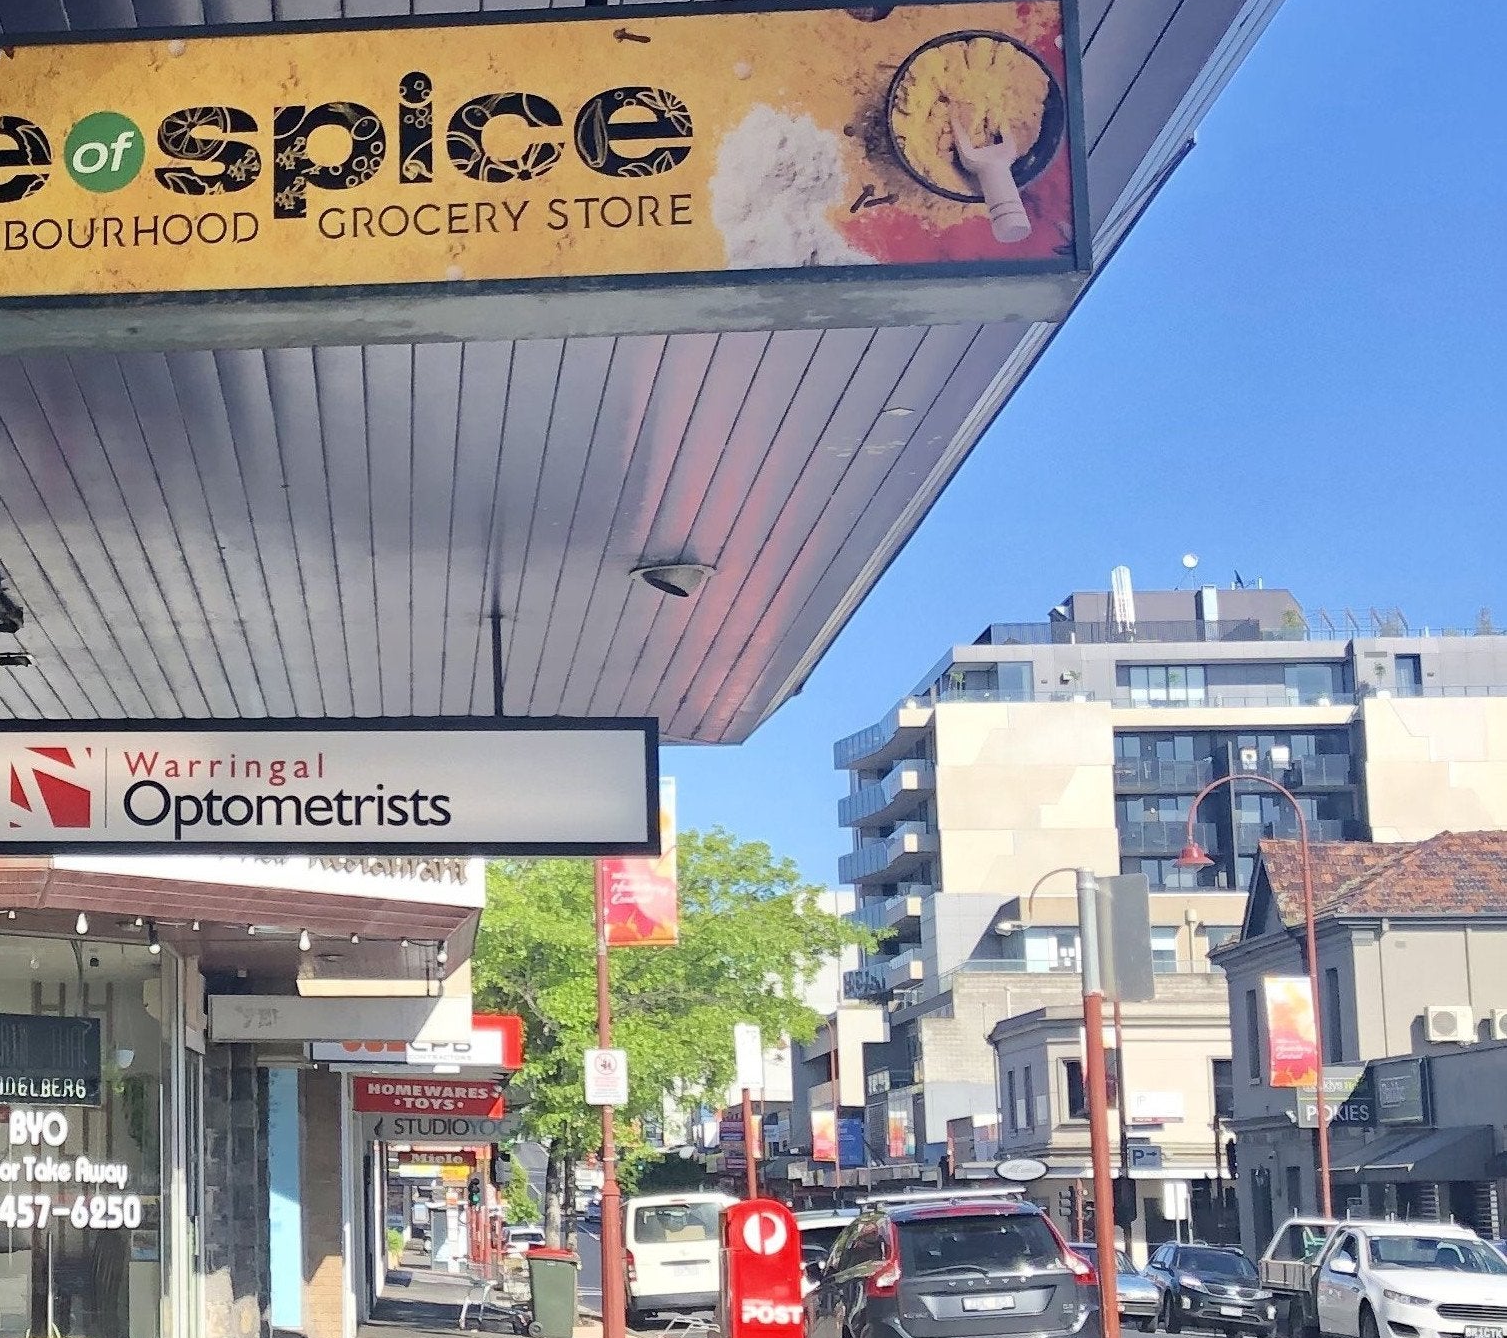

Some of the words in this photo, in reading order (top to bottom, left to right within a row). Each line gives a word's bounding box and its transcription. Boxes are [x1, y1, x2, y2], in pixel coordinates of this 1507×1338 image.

[72, 128, 133, 176] of
[155, 70, 694, 220] spice
[319, 200, 529, 242] GROCERY
[547, 193, 693, 232] STORE
[124, 751, 325, 786] Warringal
[123, 780, 453, 840] Optometrists
[367, 1082, 489, 1100] HOMEWARES
[9, 1110, 69, 1147] BYO
[0, 1162, 21, 1182] or
[23, 1155, 72, 1183] Take
[75, 1155, 128, 1190] Away
[741, 1304, 804, 1325] POST
